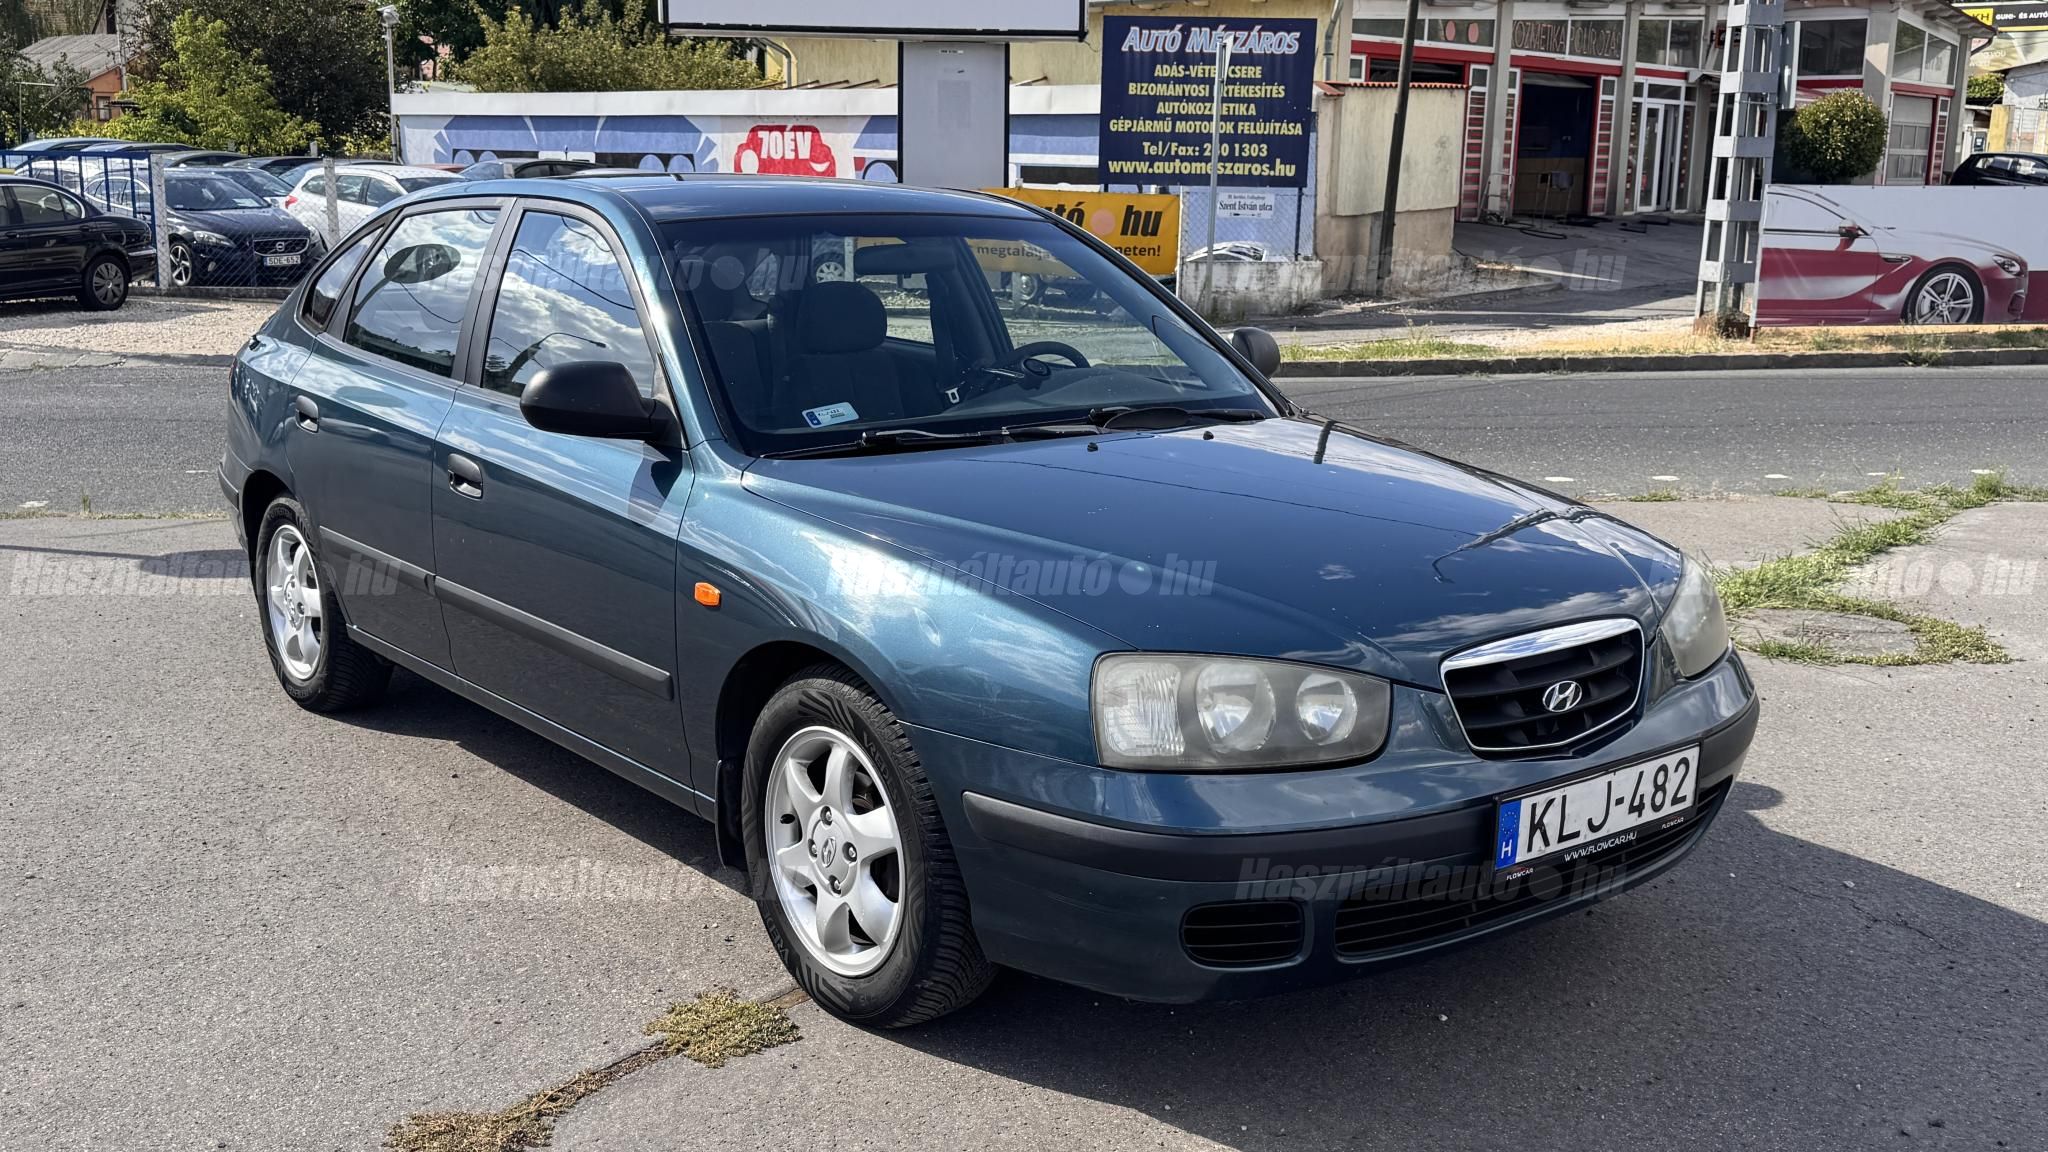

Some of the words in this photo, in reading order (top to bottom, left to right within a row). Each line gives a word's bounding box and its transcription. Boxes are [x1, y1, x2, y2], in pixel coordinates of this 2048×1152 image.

[1121, 24, 1183, 52] AUTÓ
[1128, 81, 1209, 96] BIZOMÁNYOSI
[1214, 82, 1286, 98] RTÉKESÍTÉS
[1157, 100, 1256, 116] AUTÓKOZETIKA
[1110, 116, 1172, 132] GÉPJÁRMŰ
[1238, 119, 1302, 135] FELÚJÍTÁSA
[1143, 141, 1199, 157] Tel/Fax:
[1203, 143, 1229, 156] 20
[1234, 143, 1268, 157] 1303
[1527, 757, 1690, 853] KLJ-482
[1500, 839, 1512, 859] H
[1564, 831, 1637, 862] WWW.FLOWCAR.HU
[1506, 867, 1534, 880] FLOWCAR
